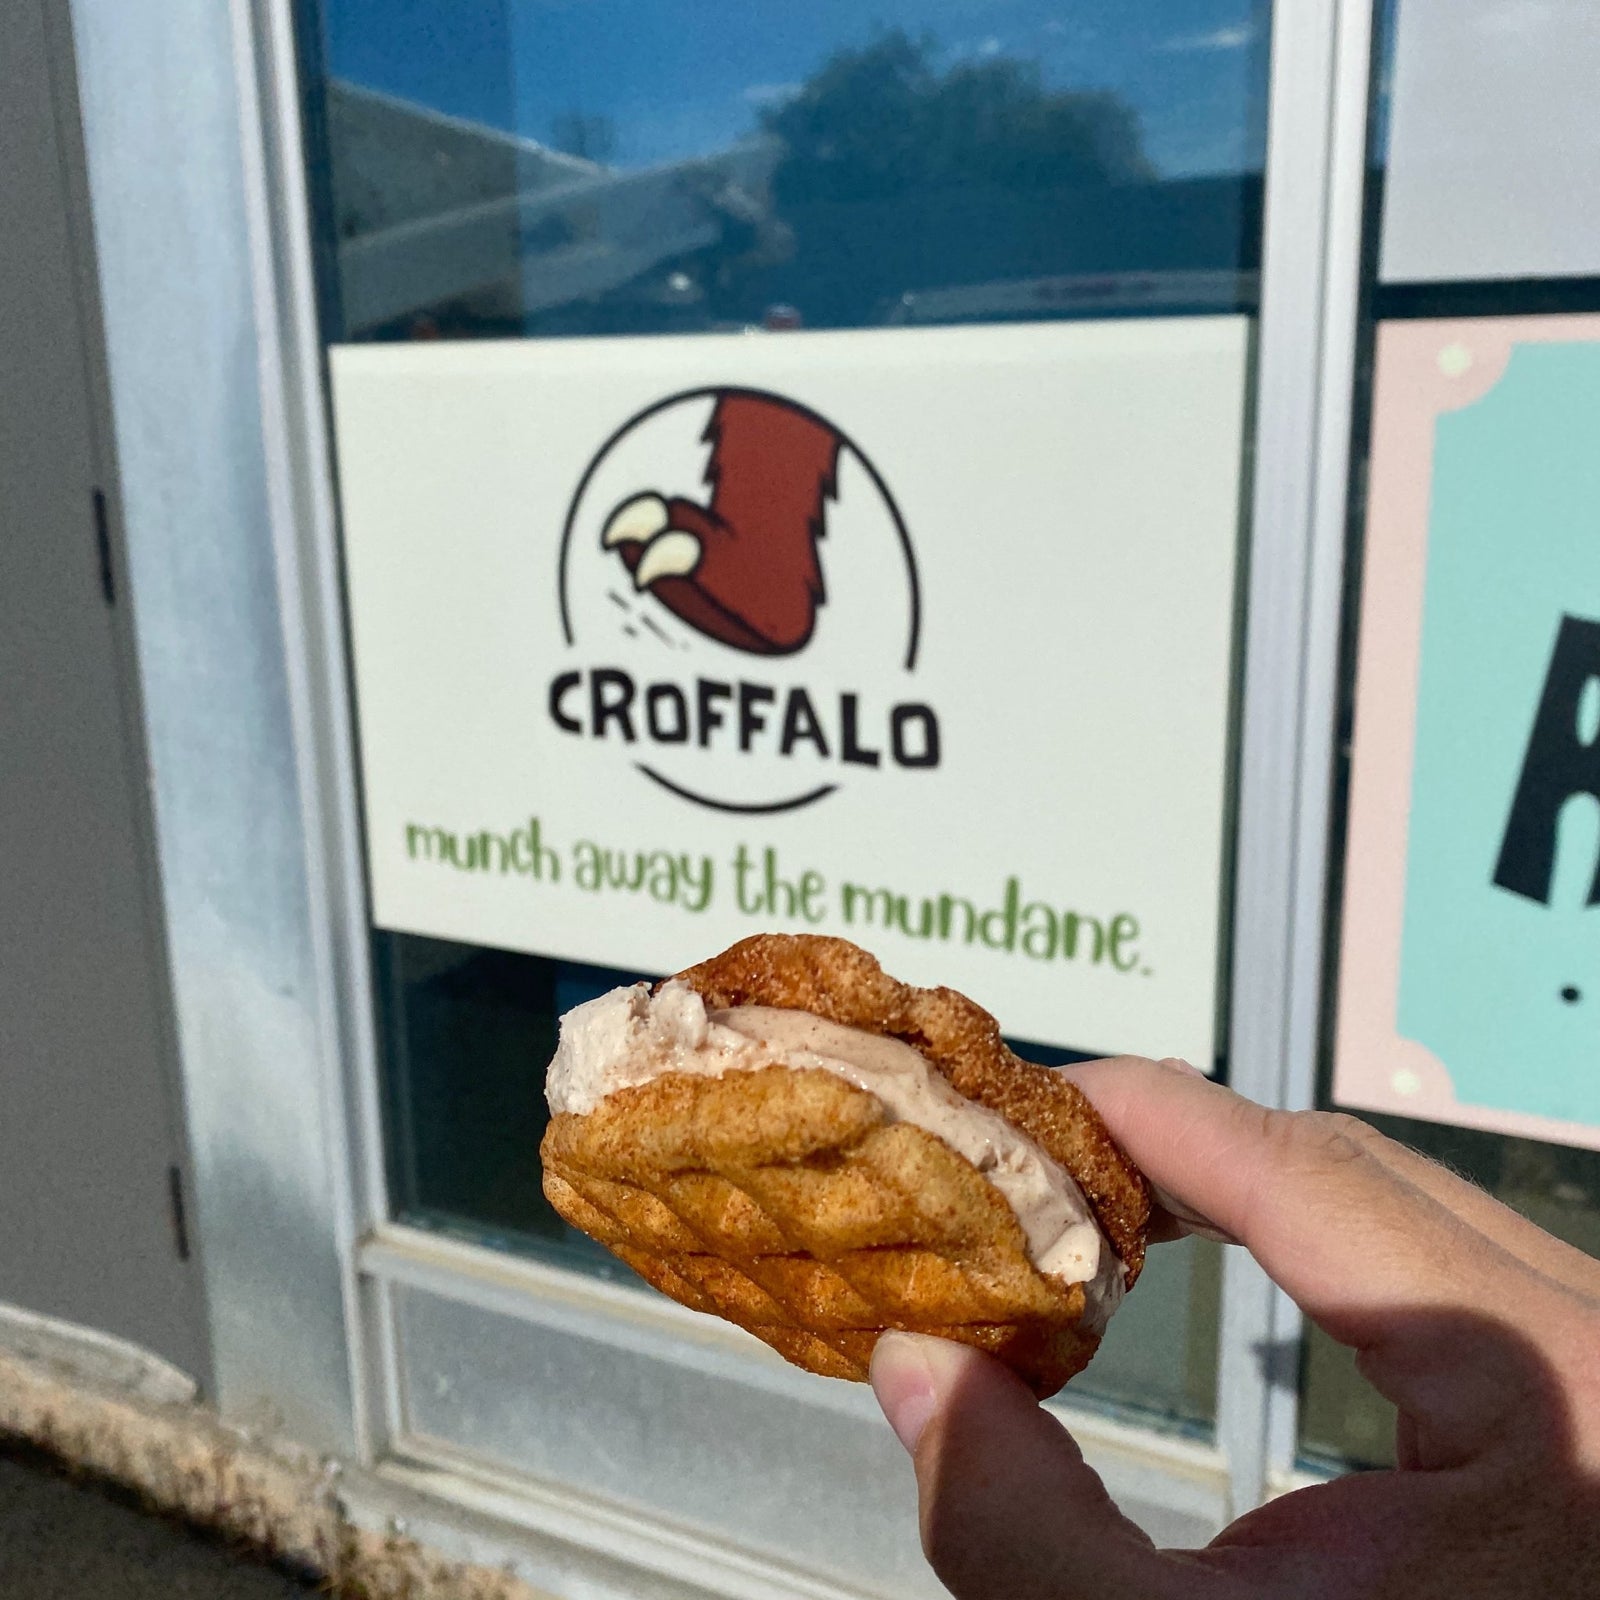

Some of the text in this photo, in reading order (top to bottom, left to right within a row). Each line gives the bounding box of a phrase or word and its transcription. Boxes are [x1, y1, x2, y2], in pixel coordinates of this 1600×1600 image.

[547, 667, 942, 770] CROFFALO
[404, 815, 1155, 979] munch away the mundane.
